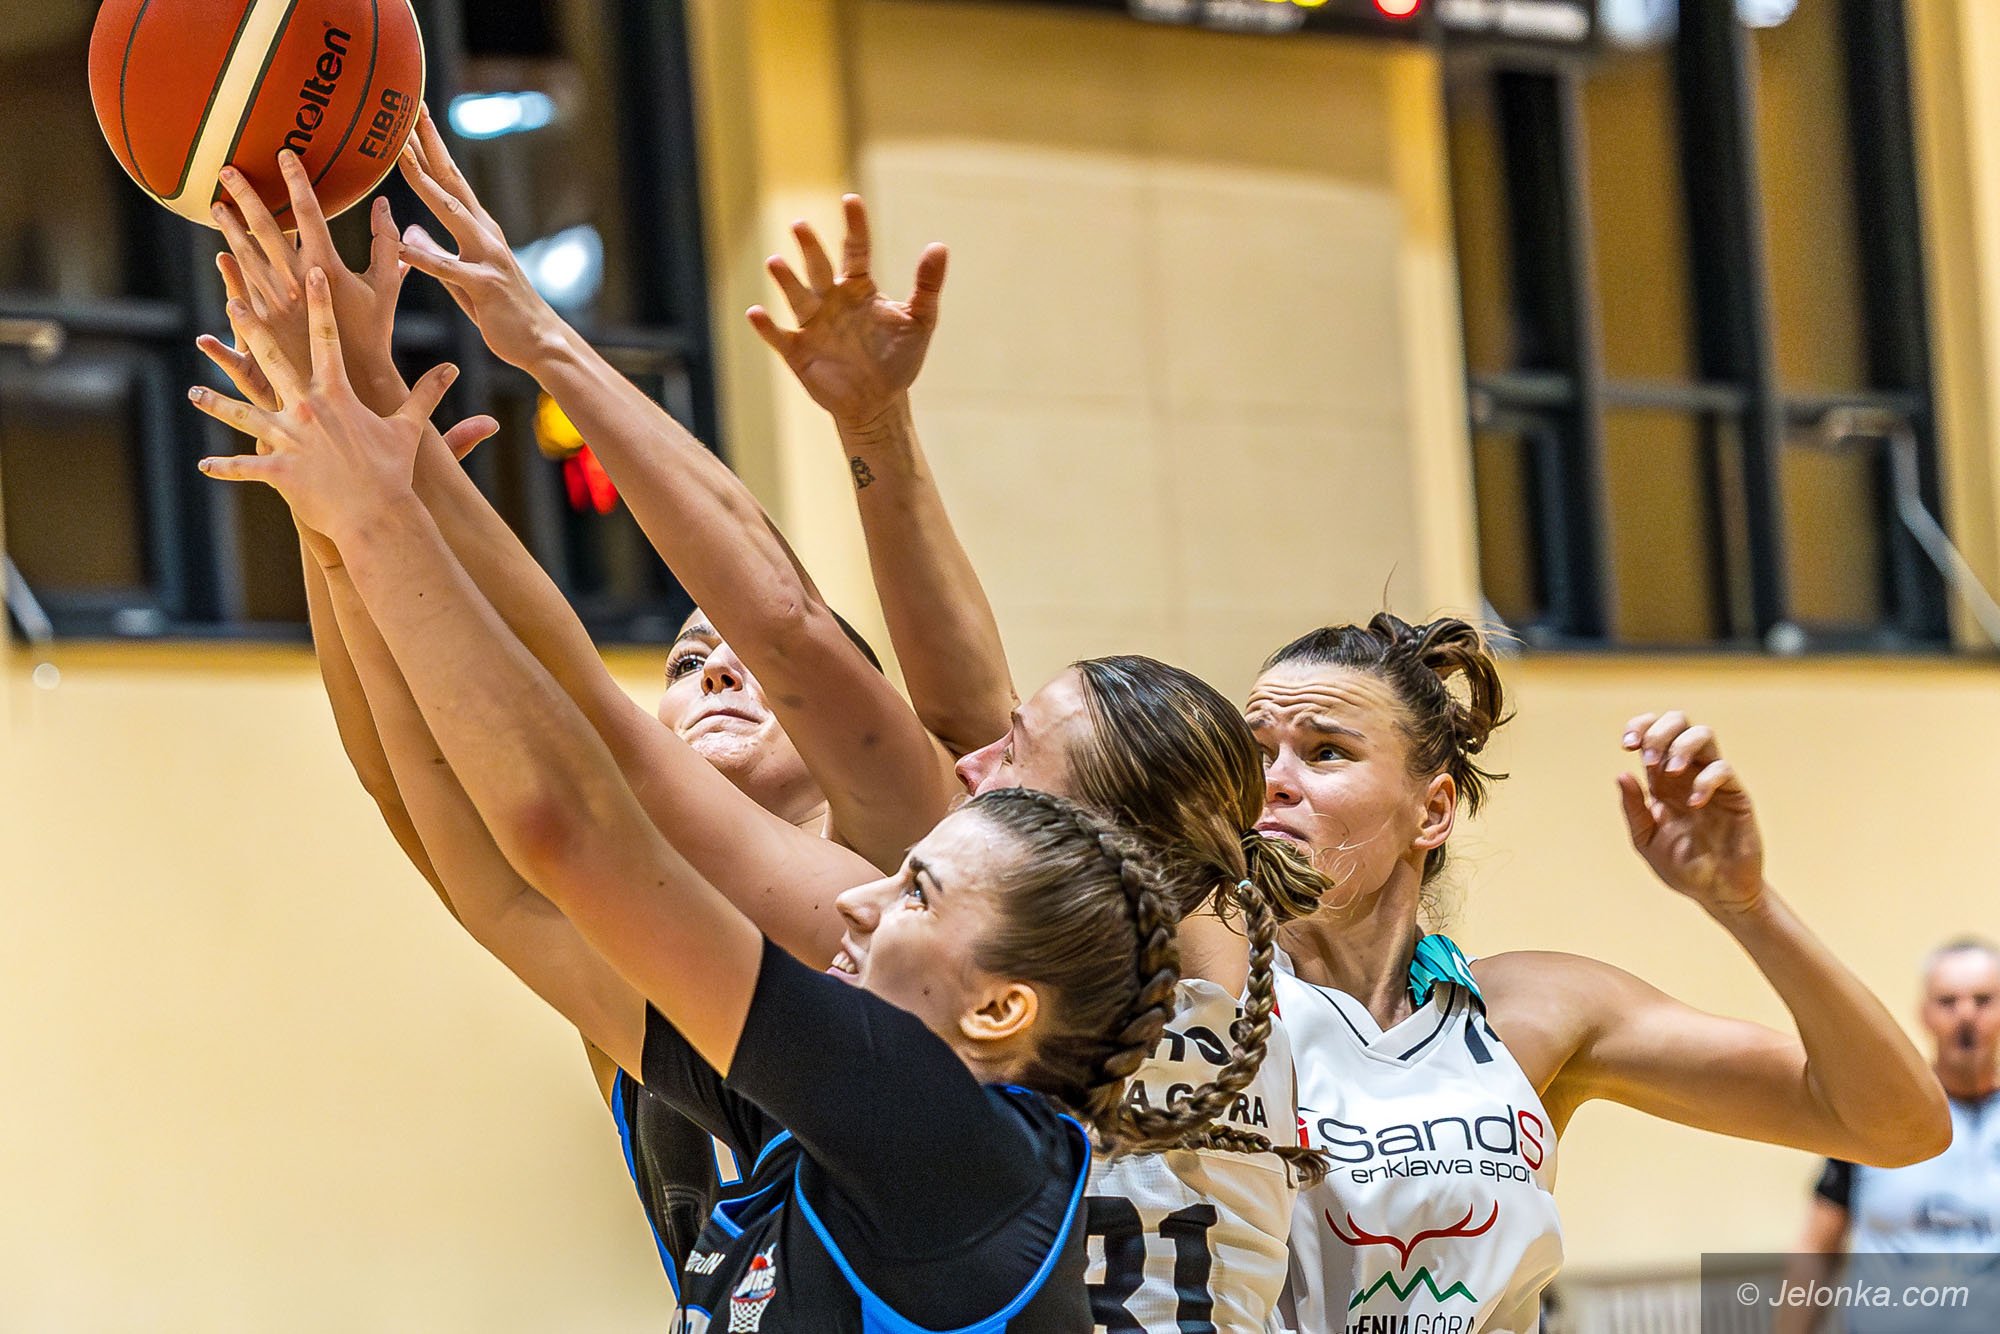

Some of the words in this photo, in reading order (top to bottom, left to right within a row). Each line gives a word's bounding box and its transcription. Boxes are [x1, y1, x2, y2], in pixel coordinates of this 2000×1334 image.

[275, 27, 352, 156] molten
[357, 88, 403, 158] FIBA
[1165, 1082, 1269, 1129] GRA
[1351, 1155, 1473, 1184] enklawa
